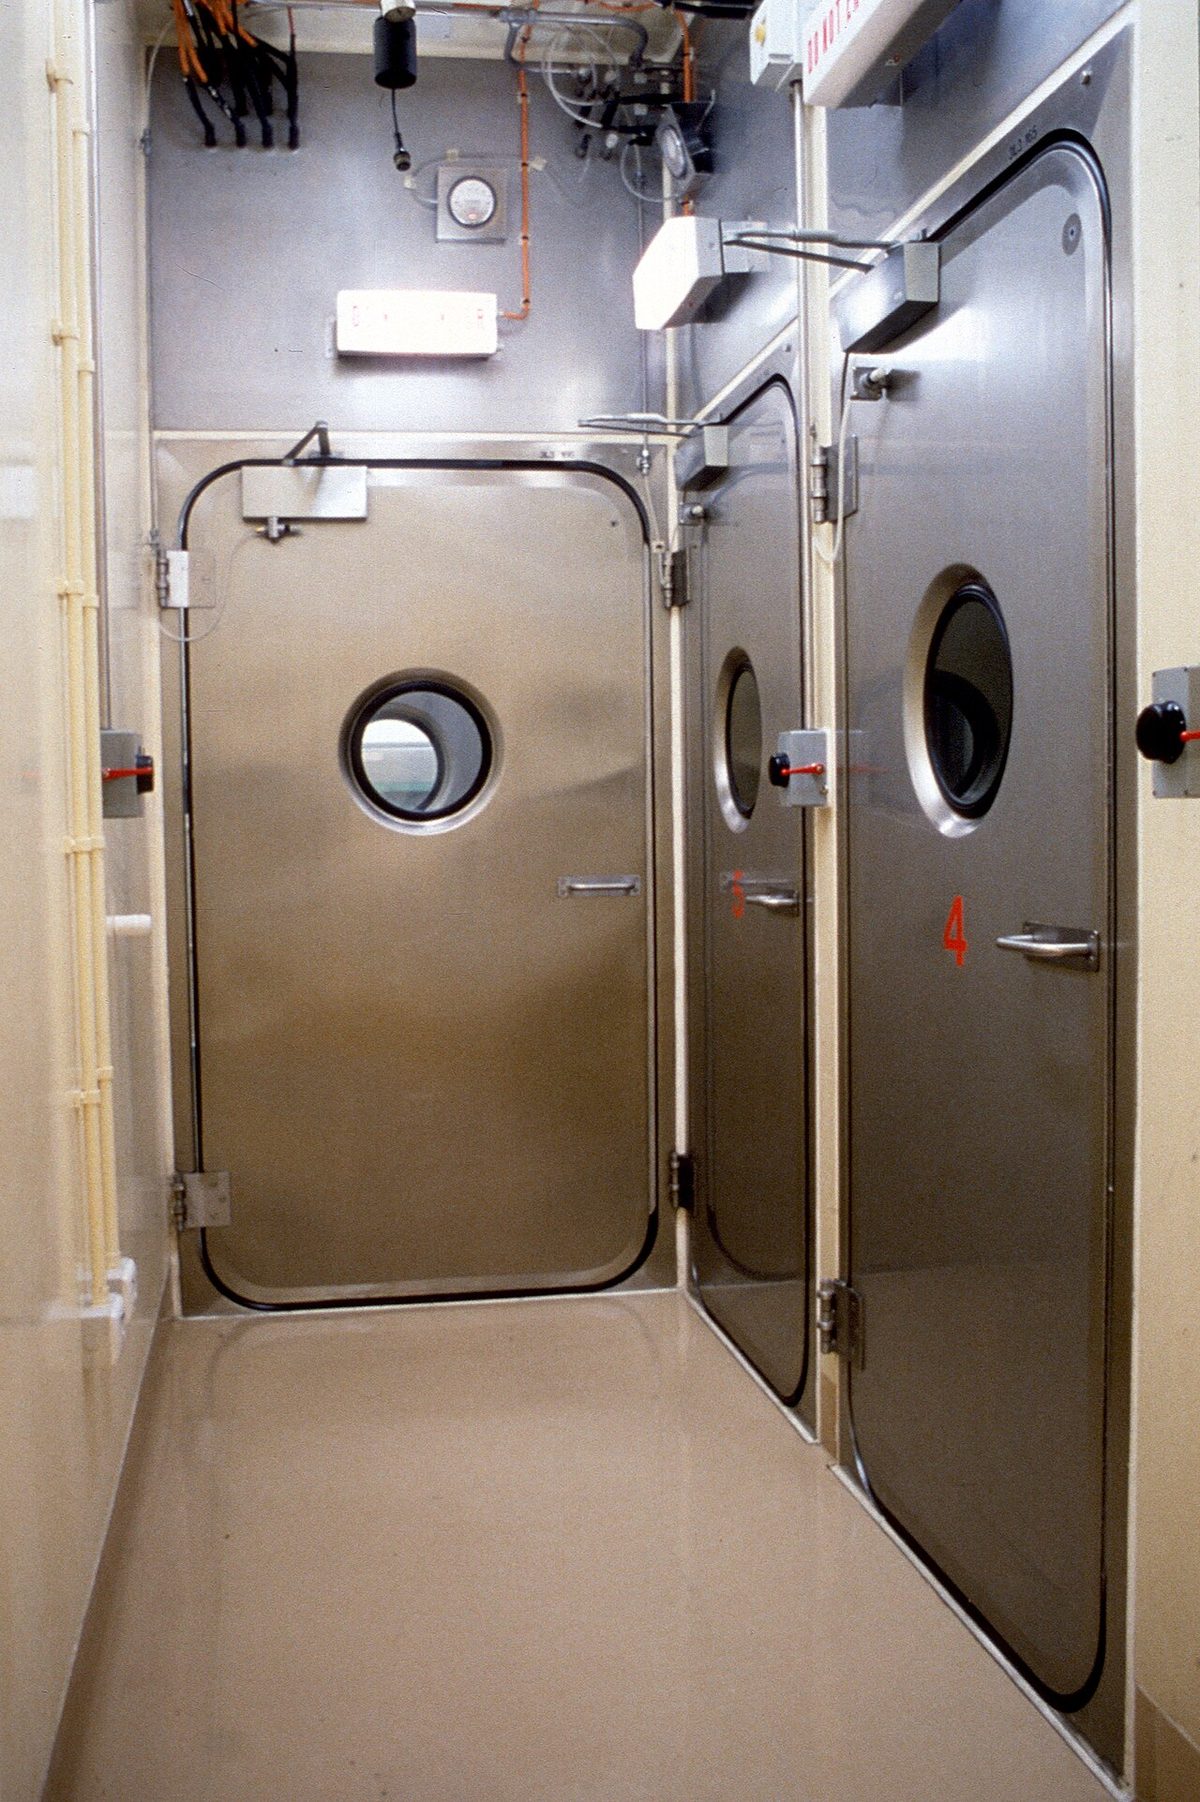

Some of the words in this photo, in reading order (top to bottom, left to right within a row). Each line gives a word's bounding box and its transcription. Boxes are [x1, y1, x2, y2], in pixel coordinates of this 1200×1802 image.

[807, 30, 820, 75] DO
[822, 0, 841, 54] NOT
[943, 895, 968, 968] 4
